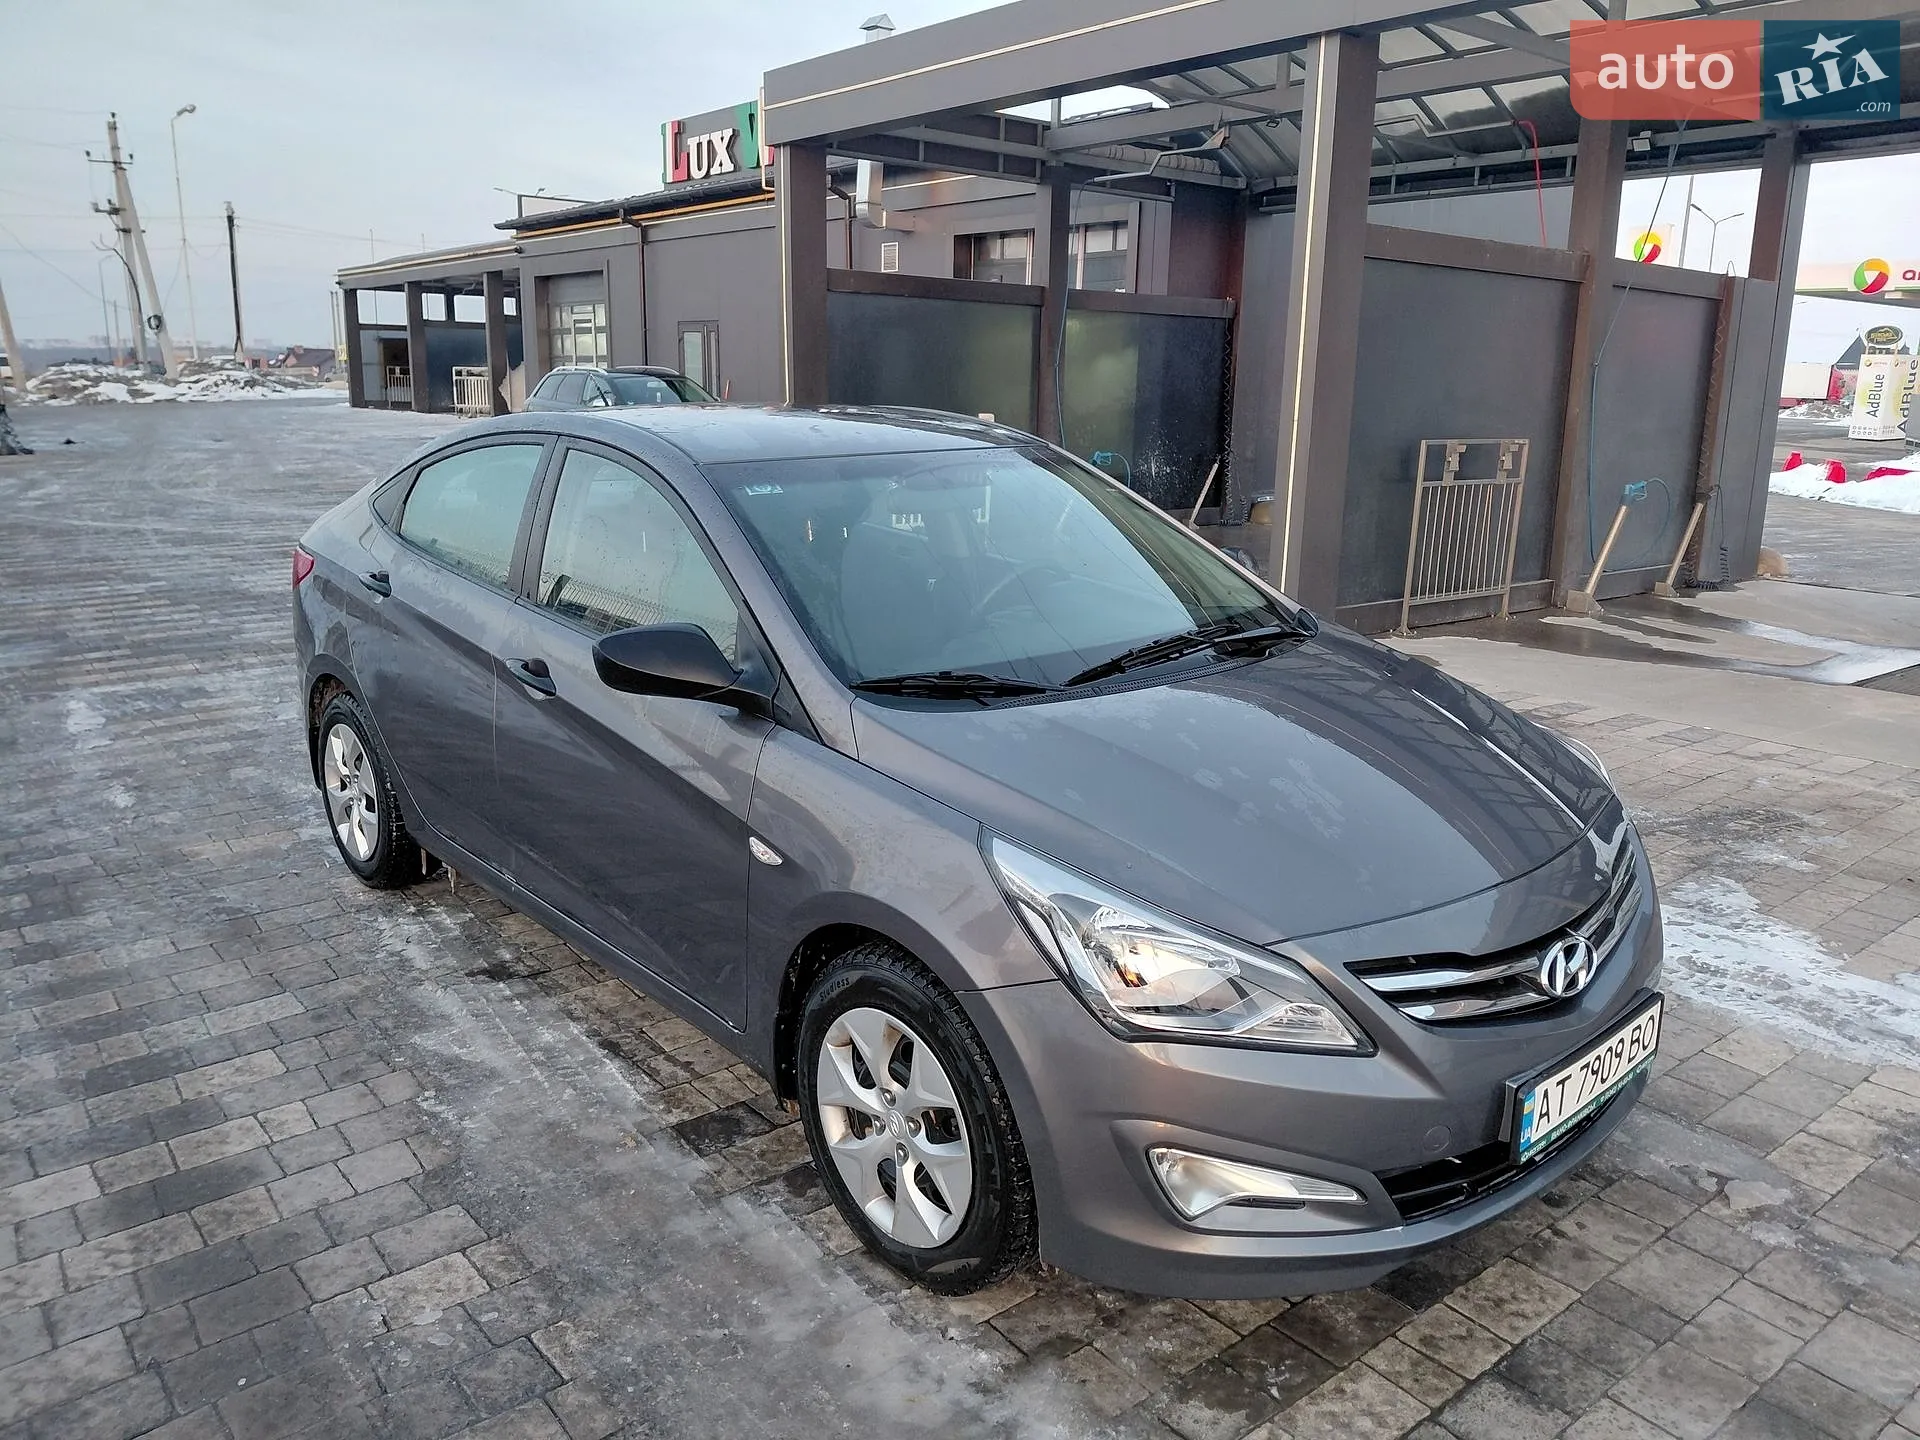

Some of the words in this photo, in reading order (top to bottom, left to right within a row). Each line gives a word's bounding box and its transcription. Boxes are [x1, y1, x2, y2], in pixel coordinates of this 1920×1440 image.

[661, 120, 735, 184] LUX
[1866, 374, 1885, 418] AdBlue
[819, 977, 850, 1002] Studless
[1535, 1074, 1572, 1133] AT
[1576, 1037, 1625, 1105] 7909
[1628, 1014, 1655, 1065] BO
[1521, 1126, 1532, 1142] UA
